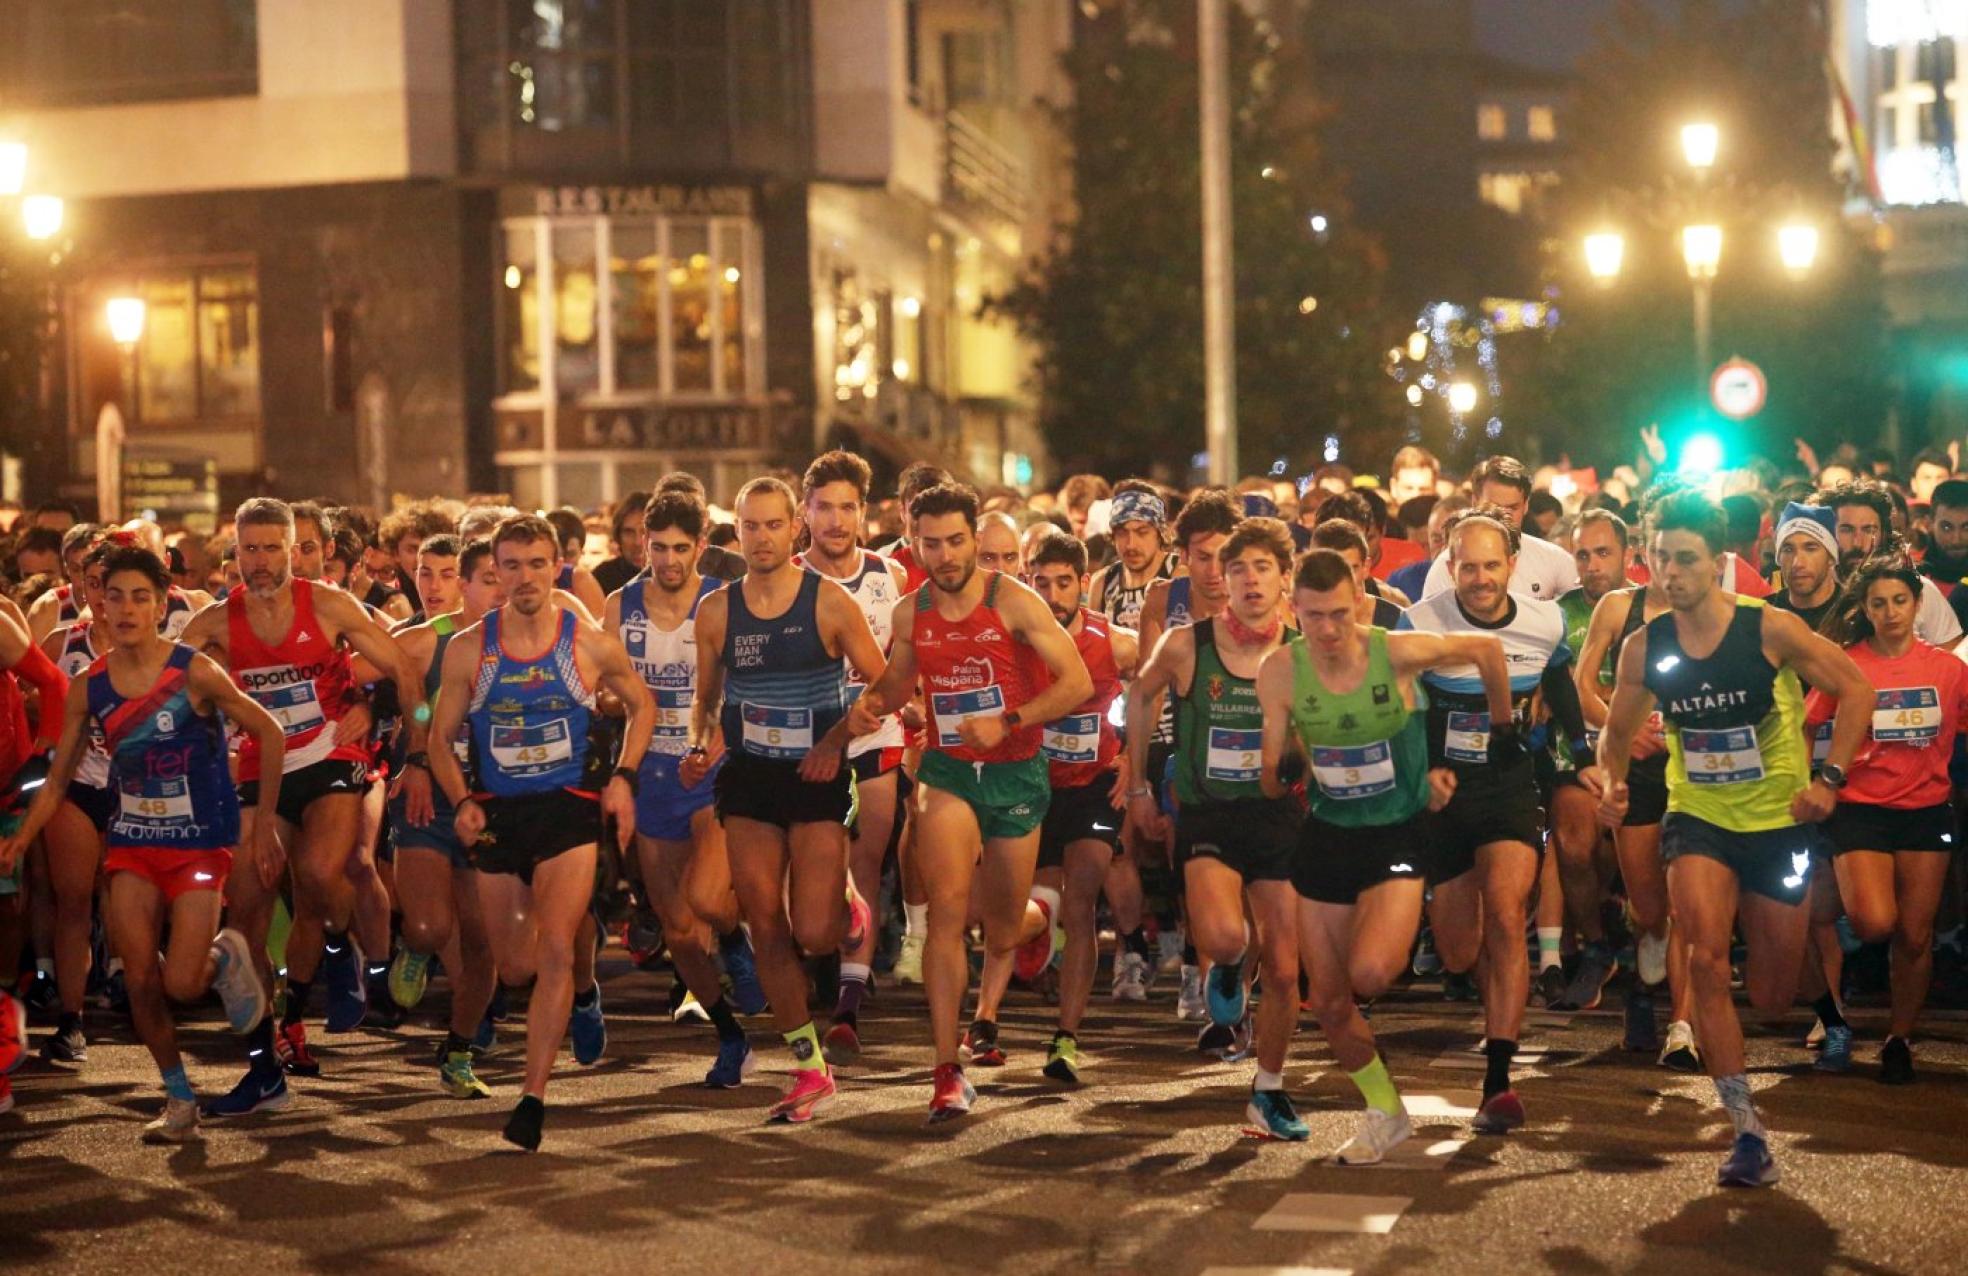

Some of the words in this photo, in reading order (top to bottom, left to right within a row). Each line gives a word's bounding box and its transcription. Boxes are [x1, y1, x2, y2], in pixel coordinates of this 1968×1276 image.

[734, 634, 771, 646] EVERY
[734, 646, 760, 657] MAN
[735, 656, 765, 668] JACK
[1671, 690, 1747, 713] ALTAFIT
[1895, 710, 1924, 726] 46
[767, 729, 782, 744] 6
[1051, 735, 1079, 750] 49
[516, 747, 548, 762] 43
[1240, 753, 1255, 767] 2
[1703, 753, 1735, 770] 34
[1344, 768, 1360, 784] 3
[138, 801, 167, 815] 48
